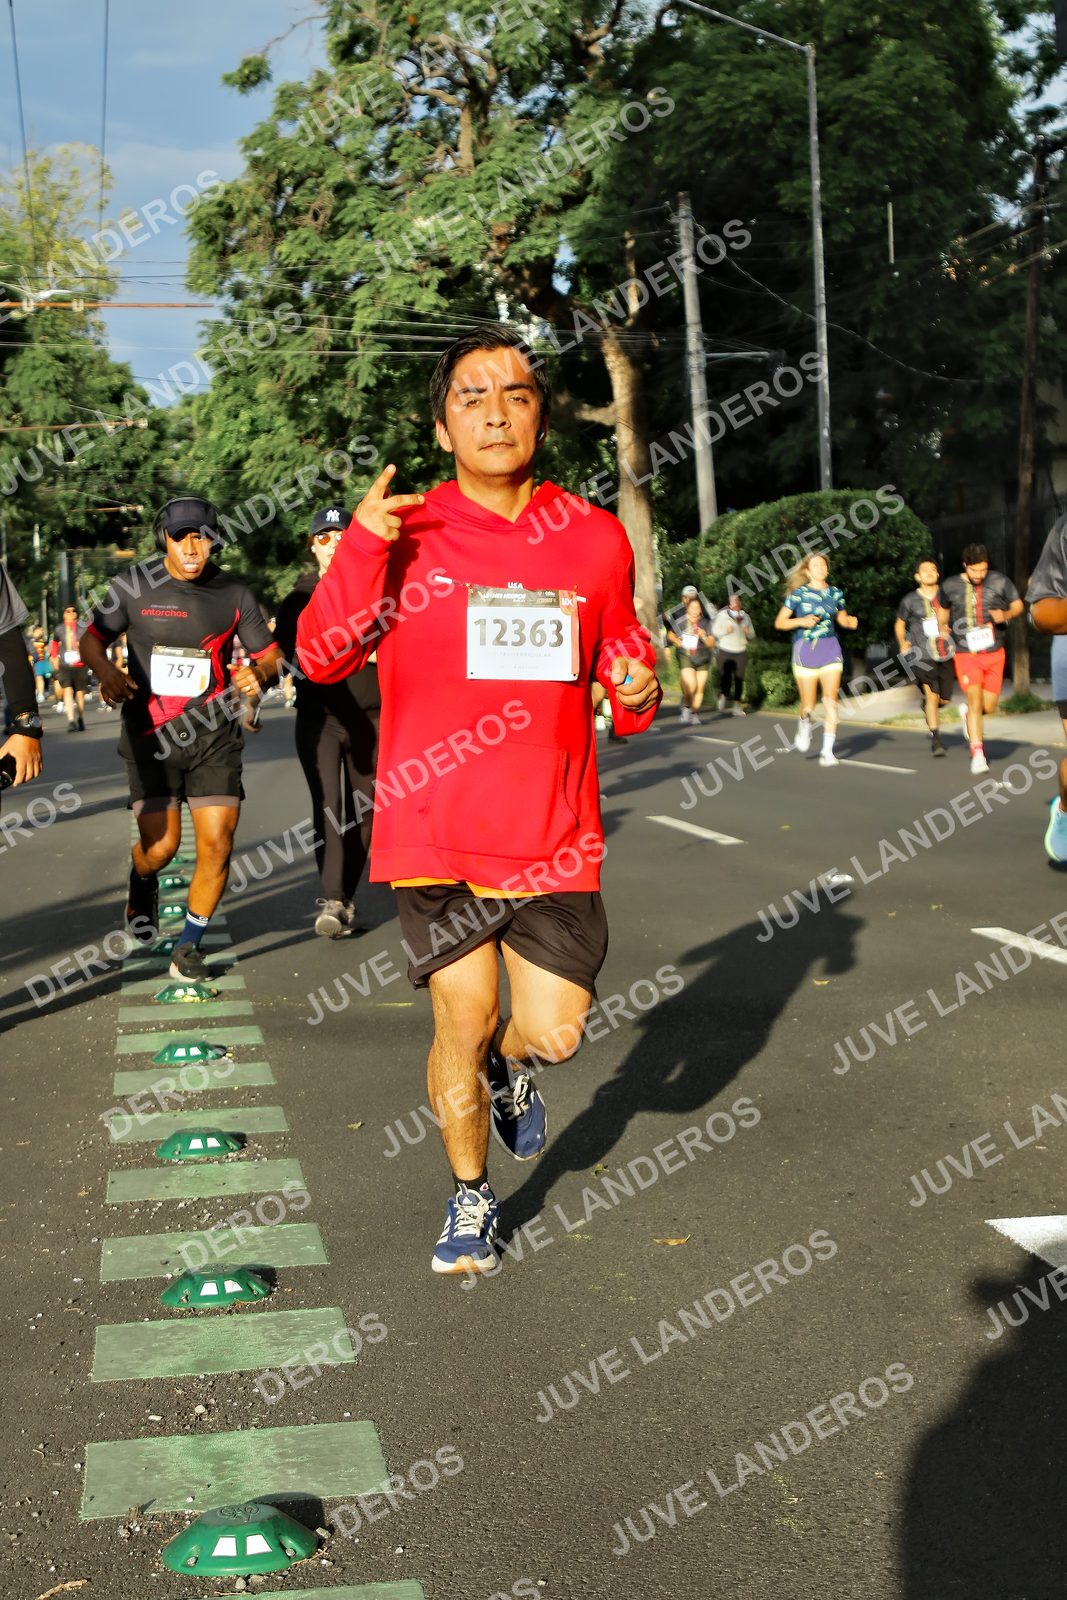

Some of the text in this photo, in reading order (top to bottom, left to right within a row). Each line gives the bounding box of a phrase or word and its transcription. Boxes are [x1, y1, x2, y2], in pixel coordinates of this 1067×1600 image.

[508, 582, 523, 590] USA
[141, 608, 188, 618] antorchas
[474, 618, 564, 648] 12363
[167, 663, 195, 678] 757
